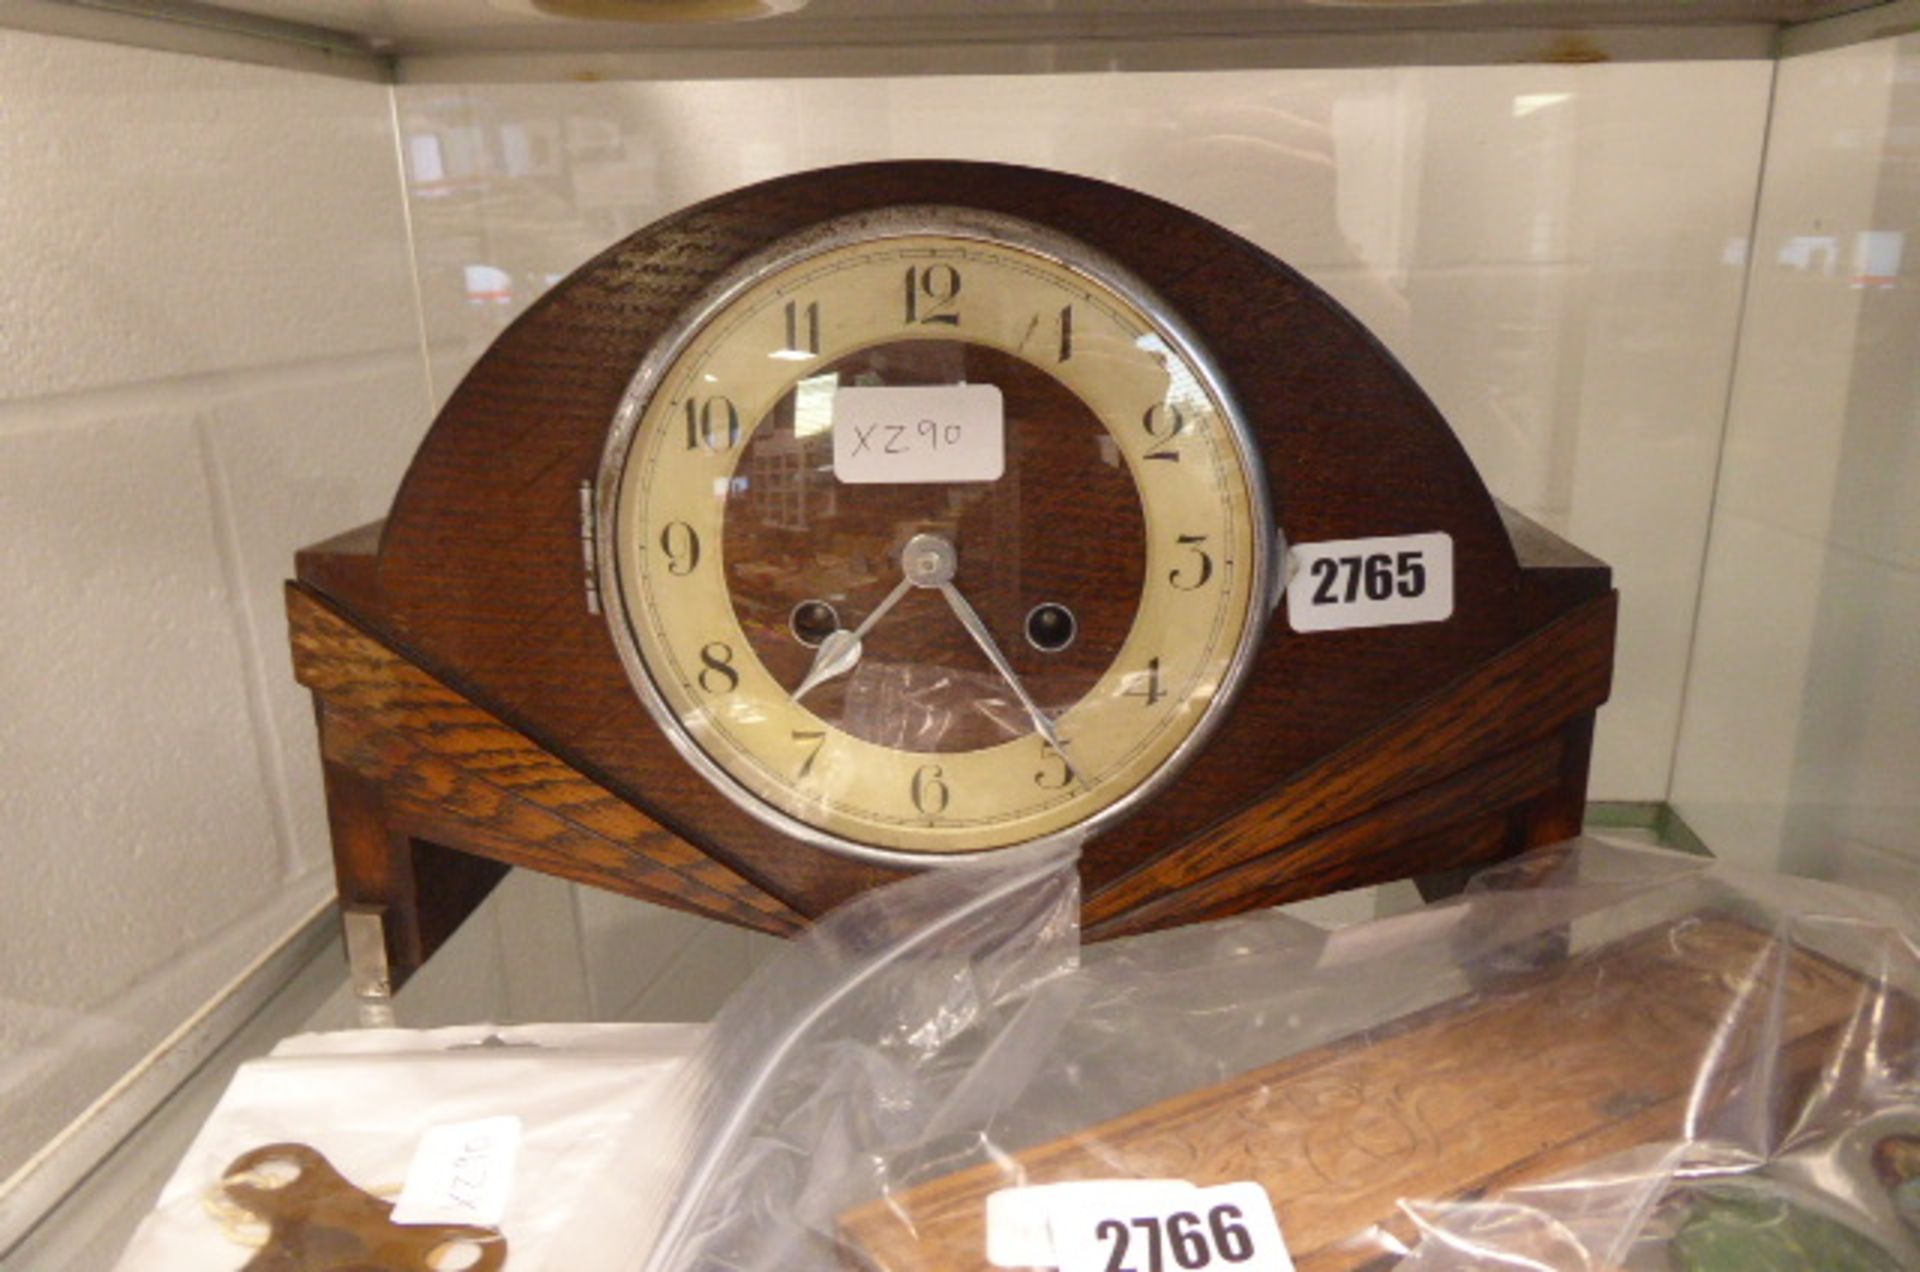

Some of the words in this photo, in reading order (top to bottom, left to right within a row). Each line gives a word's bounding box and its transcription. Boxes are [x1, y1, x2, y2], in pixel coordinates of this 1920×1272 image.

[904, 264, 961, 325] 12
[784, 300, 819, 355] 11
[1055, 304, 1073, 362] 1
[682, 395, 740, 451] 10
[852, 419, 961, 457] XZ90
[1142, 403, 1183, 462] 2
[660, 521, 700, 576] 9
[1168, 534, 1213, 591] 3
[1310, 551, 1426, 606] 2765
[698, 642, 740, 694] 8
[1123, 656, 1168, 706] 4
[791, 730, 827, 778] 7
[1034, 738, 1073, 789] 5
[910, 764, 950, 815] 6
[1095, 1203, 1255, 1272] 2766
